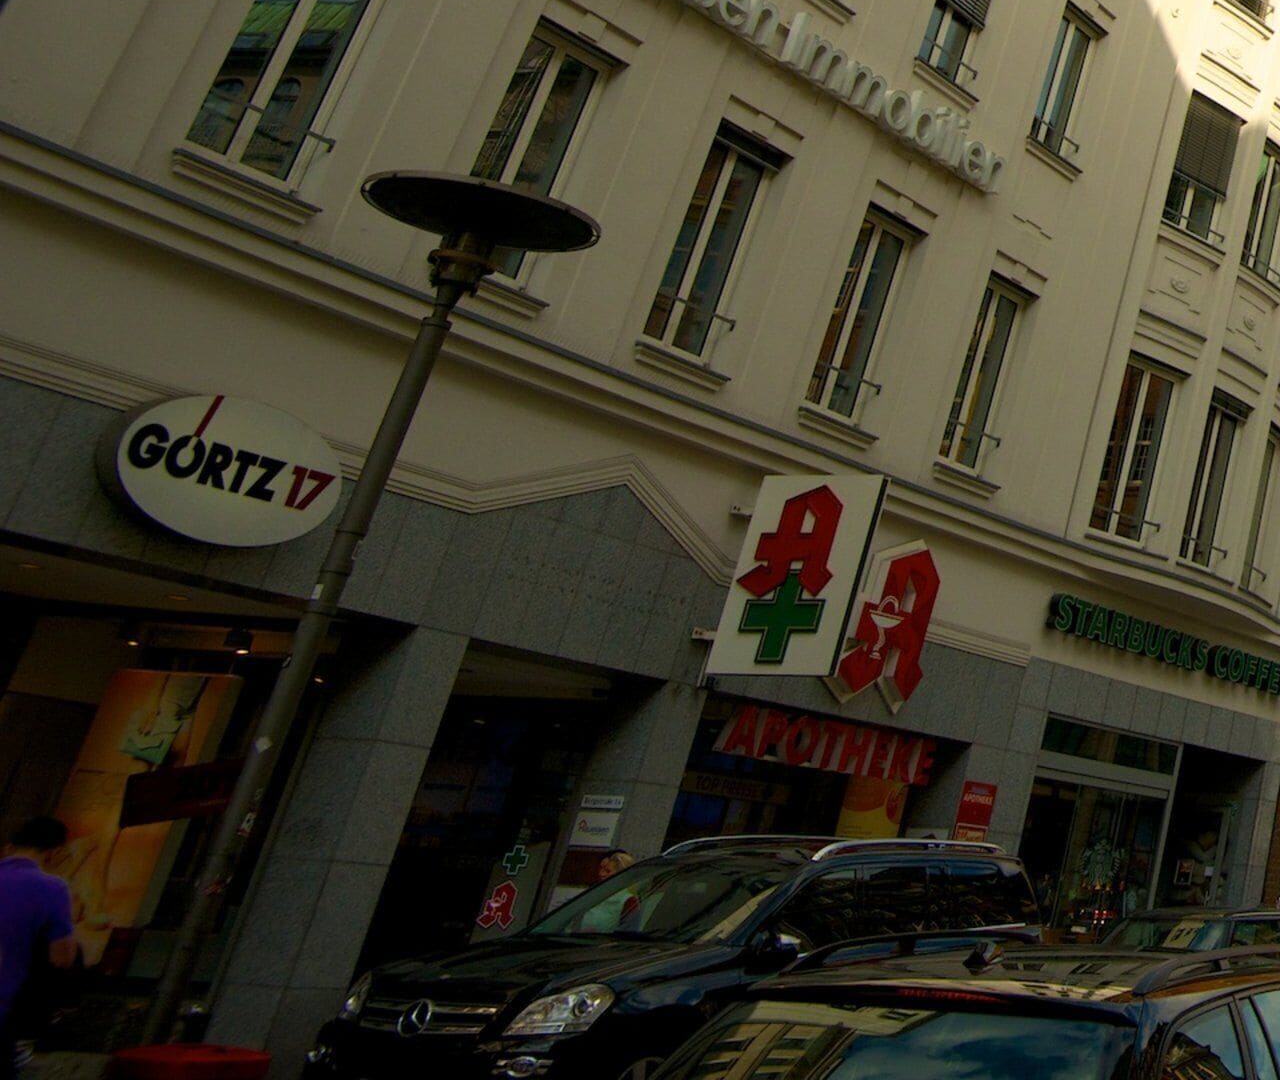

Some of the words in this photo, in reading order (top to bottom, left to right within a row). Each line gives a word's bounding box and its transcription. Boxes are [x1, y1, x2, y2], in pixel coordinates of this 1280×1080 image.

[779, 12, 1008, 194] Immobilien
[283, 465, 336, 512] 17
[1051, 593, 1210, 672] STARBUCKS
[716, 701, 938, 787] APOTHEKE
